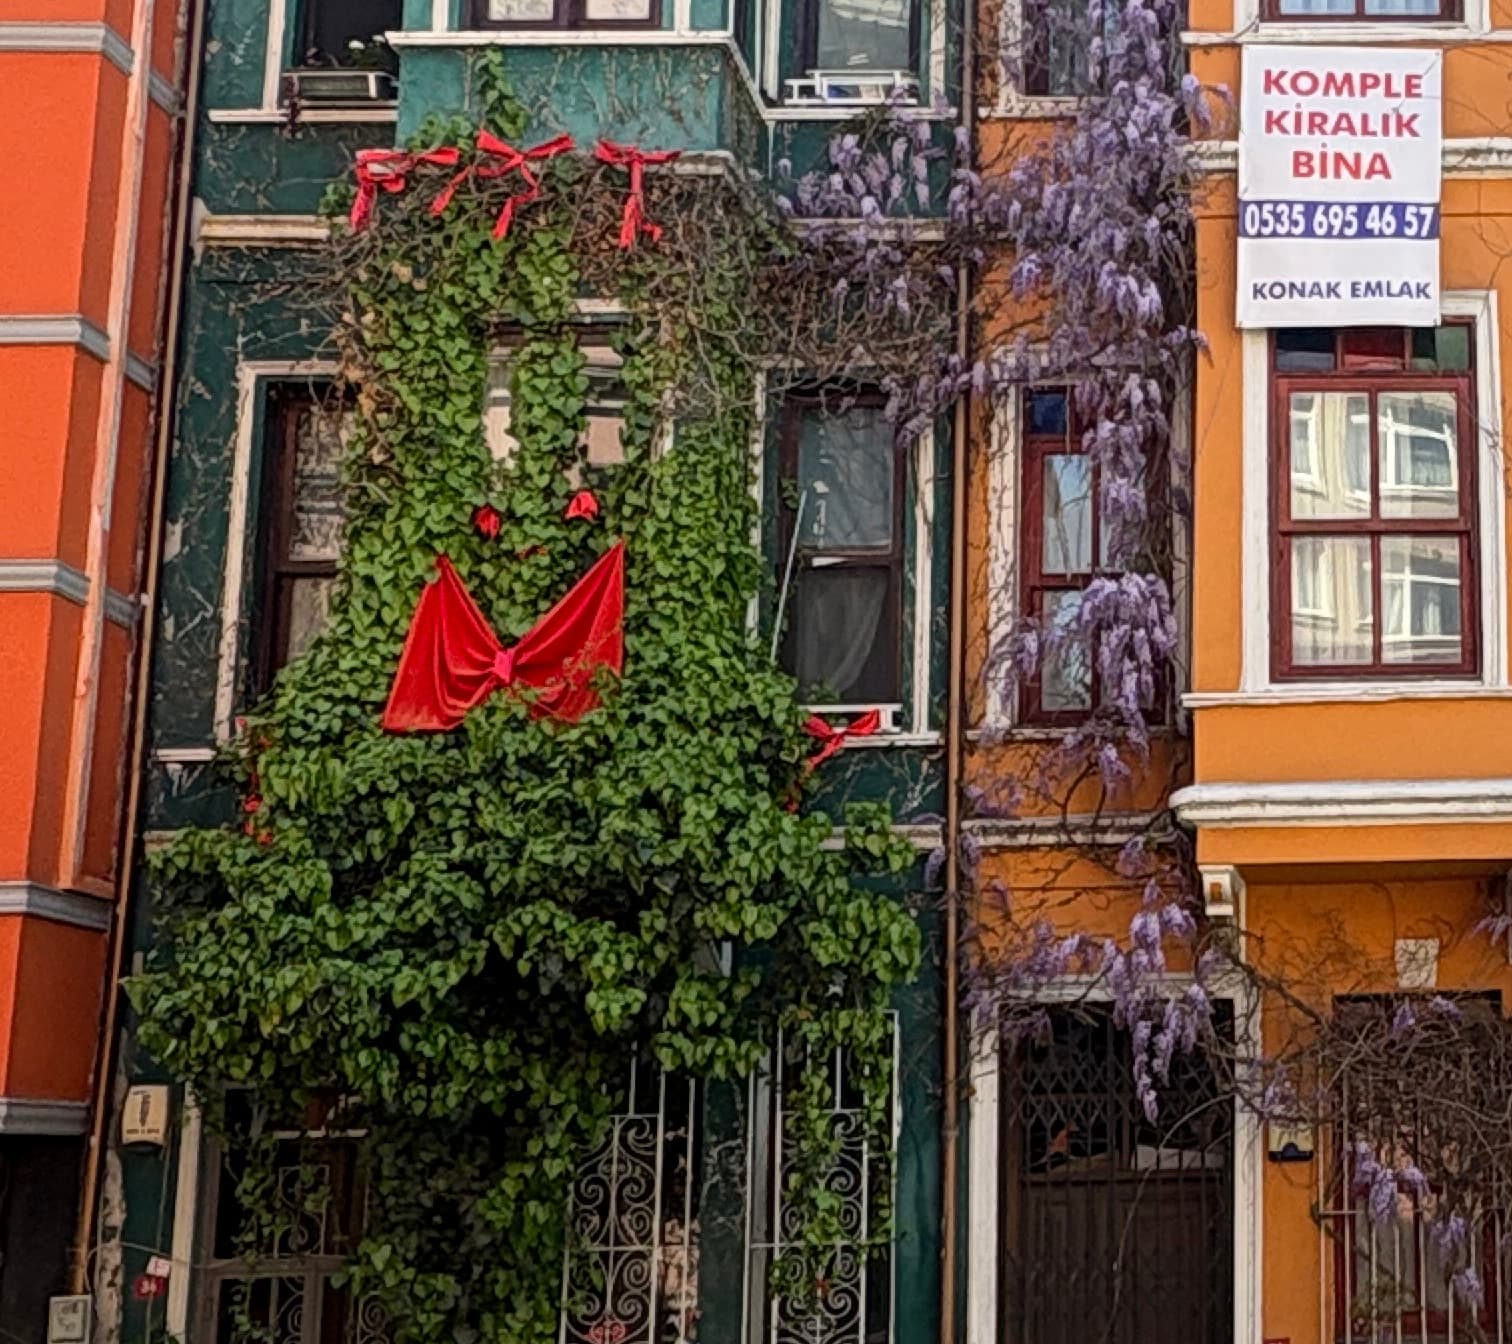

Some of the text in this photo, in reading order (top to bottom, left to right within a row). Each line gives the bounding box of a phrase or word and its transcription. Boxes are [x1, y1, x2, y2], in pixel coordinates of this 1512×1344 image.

[1263, 69, 1423, 98] KOMPLE
[1264, 103, 1421, 137] KİRALIK
[1292, 143, 1392, 180] BİNA
[1244, 203, 1434, 237] 0535 695 46 57
[1252, 281, 1431, 300] KONAK EMLAK
